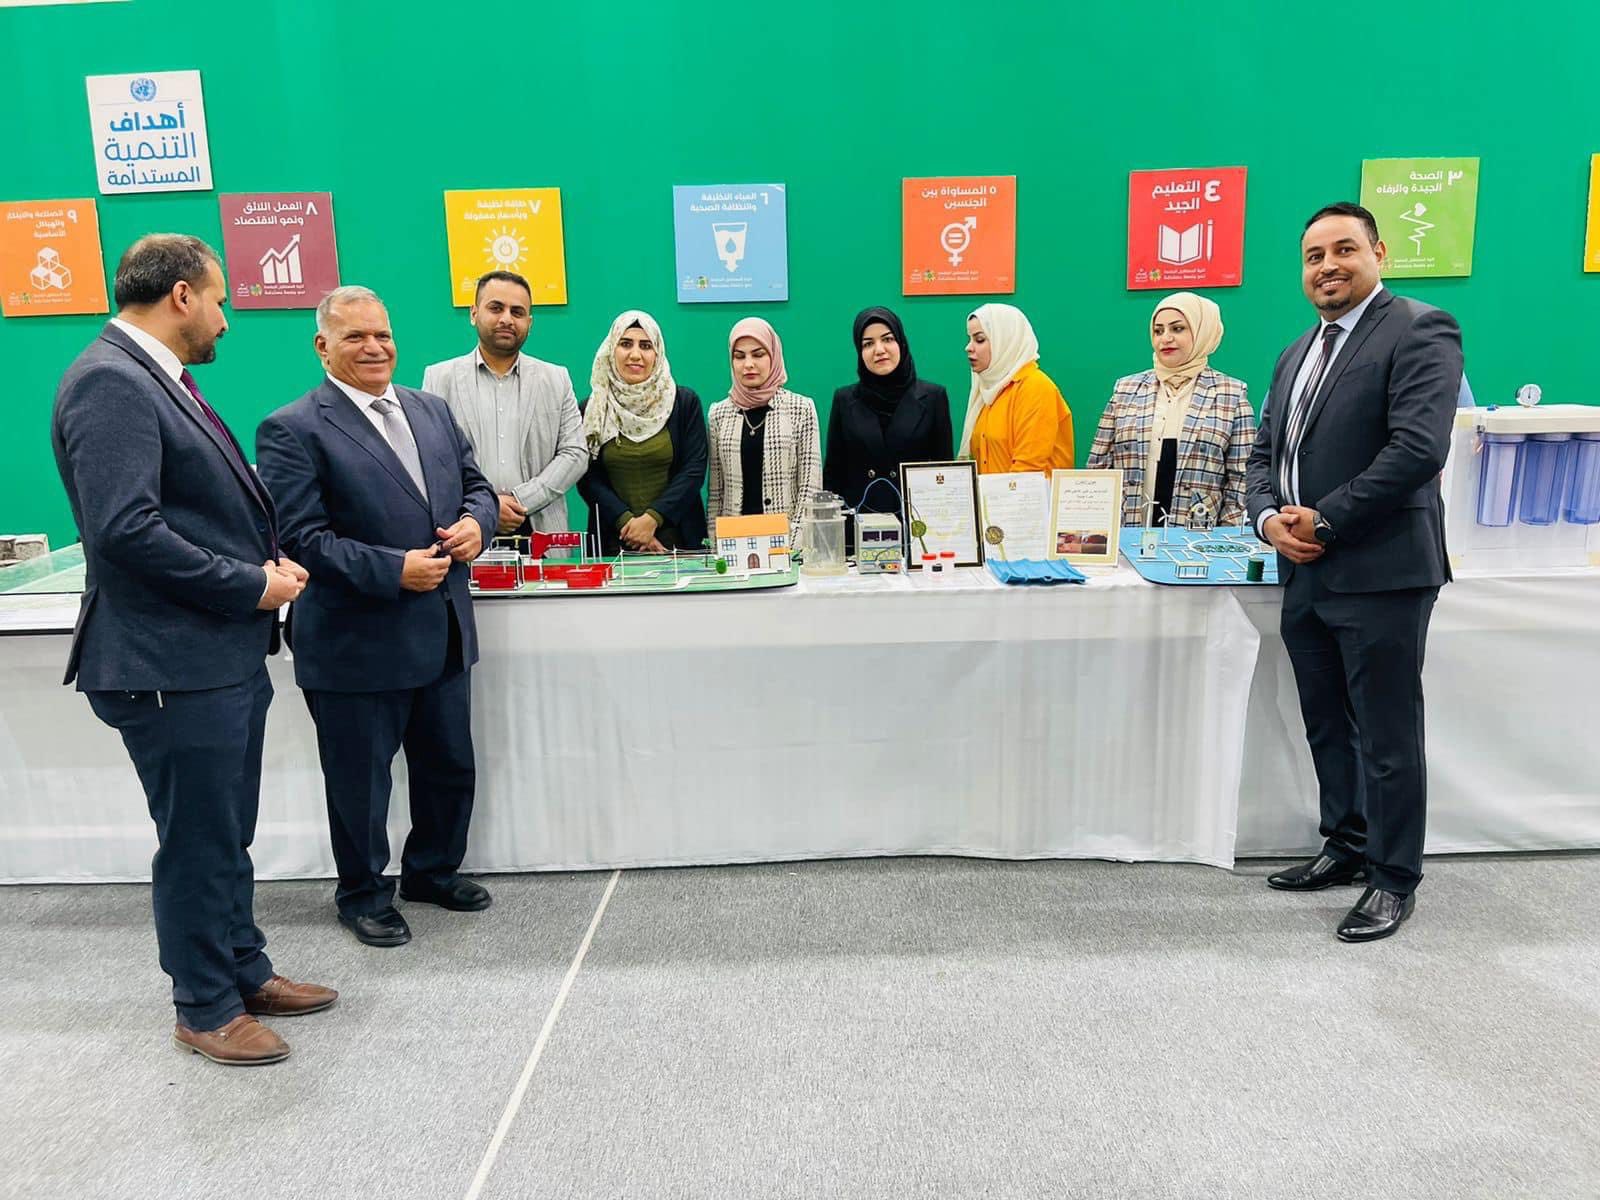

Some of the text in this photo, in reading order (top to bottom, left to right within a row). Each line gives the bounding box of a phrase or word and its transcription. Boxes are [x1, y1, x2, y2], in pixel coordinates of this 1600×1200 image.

[110, 102, 185, 132] أهداف
[104, 131, 197, 167] التنمية
[108, 165, 201, 186] المستدامة
[1409, 170, 1443, 181] الصحة
[921, 188, 938, 198] بين
[941, 186, 986, 197] المساواة
[1152, 180, 1200, 199] التعليم
[1376, 182, 1442, 195] الجيدة والرفاه
[243, 202, 271, 214] اللائق
[273, 201, 303, 212] العمل
[944, 197, 987, 209] الجنسين
[1164, 197, 1200, 213] الجيد
[234, 215, 304, 226] ونمو الاقتصاد
